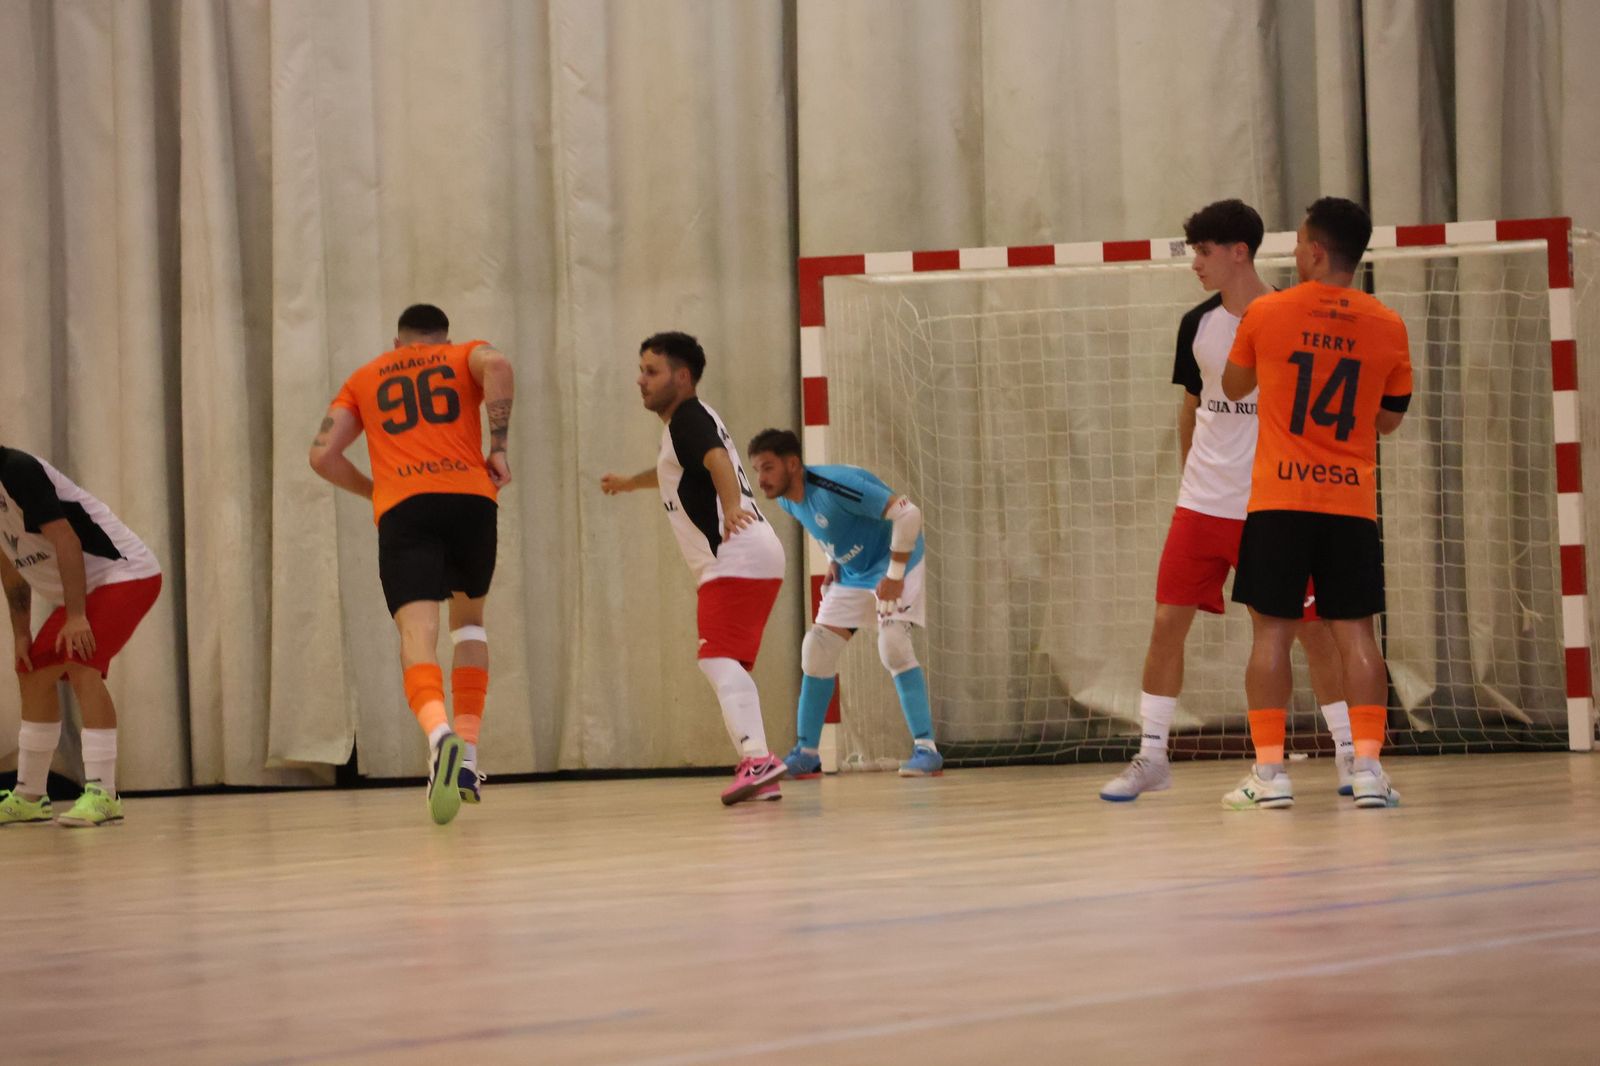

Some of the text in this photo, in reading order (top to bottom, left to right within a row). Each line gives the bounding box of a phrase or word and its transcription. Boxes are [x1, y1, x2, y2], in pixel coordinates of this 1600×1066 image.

[1301, 332, 1357, 353] TERRY
[377, 365, 460, 435] 96
[1288, 351, 1361, 441] 14
[397, 458, 469, 477] uvesa
[1278, 461, 1360, 486] uvesa
